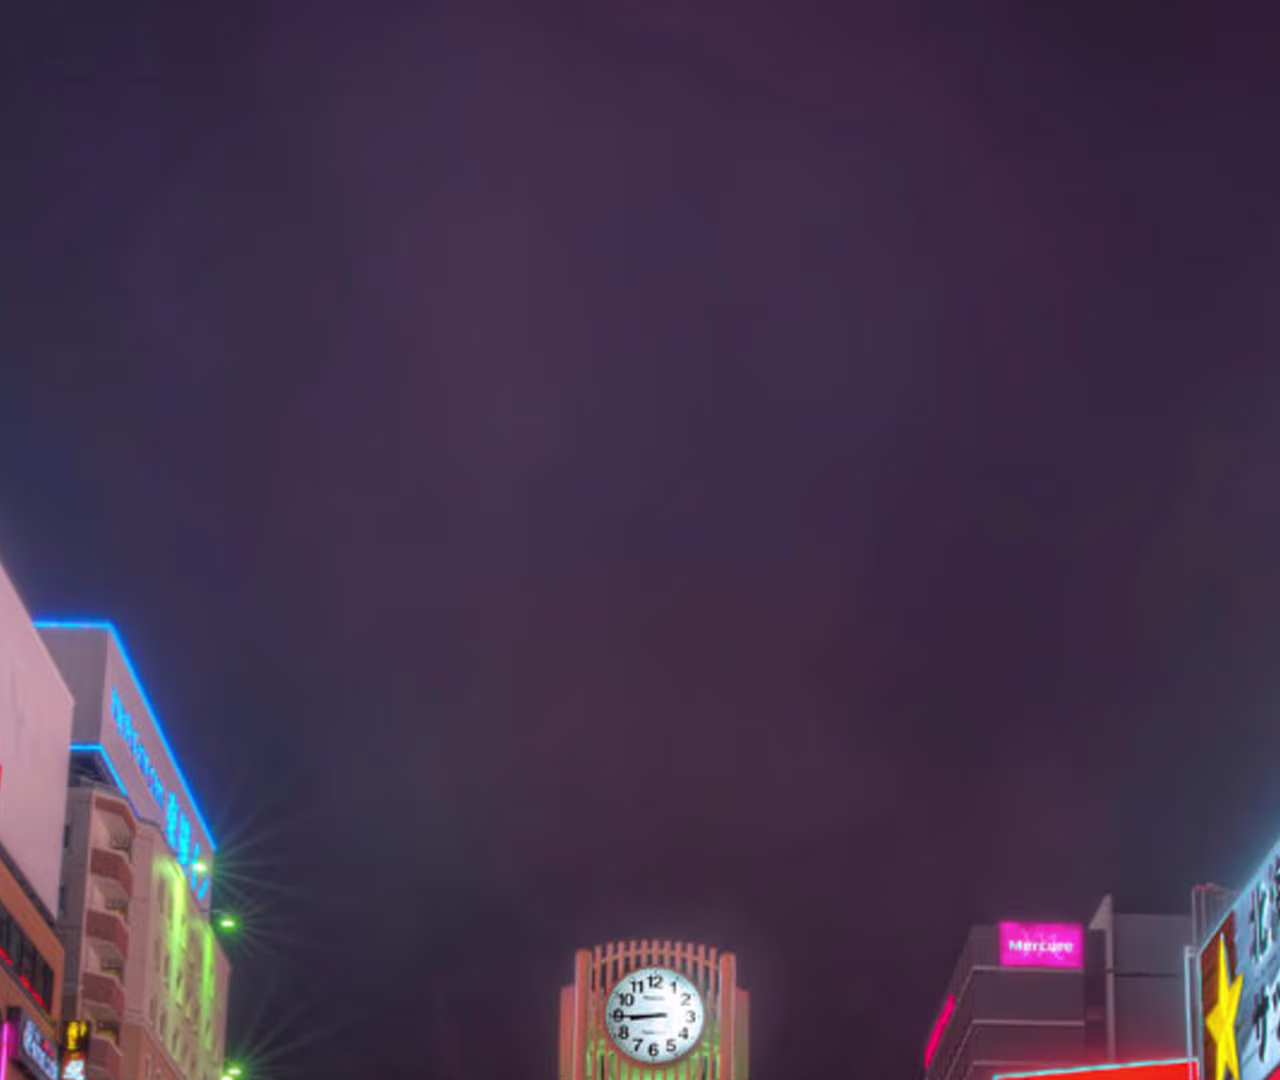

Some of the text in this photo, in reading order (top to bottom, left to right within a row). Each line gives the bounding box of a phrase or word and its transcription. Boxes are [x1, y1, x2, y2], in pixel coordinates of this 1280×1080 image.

[629, 980, 645, 994] 11
[646, 975, 664, 990] 12
[618, 992, 692, 1008] 10 2
[686, 1010, 697, 1024] 3
[619, 1025, 690, 1041] 8 4
[632, 1039, 677, 1058] 7 6 5
